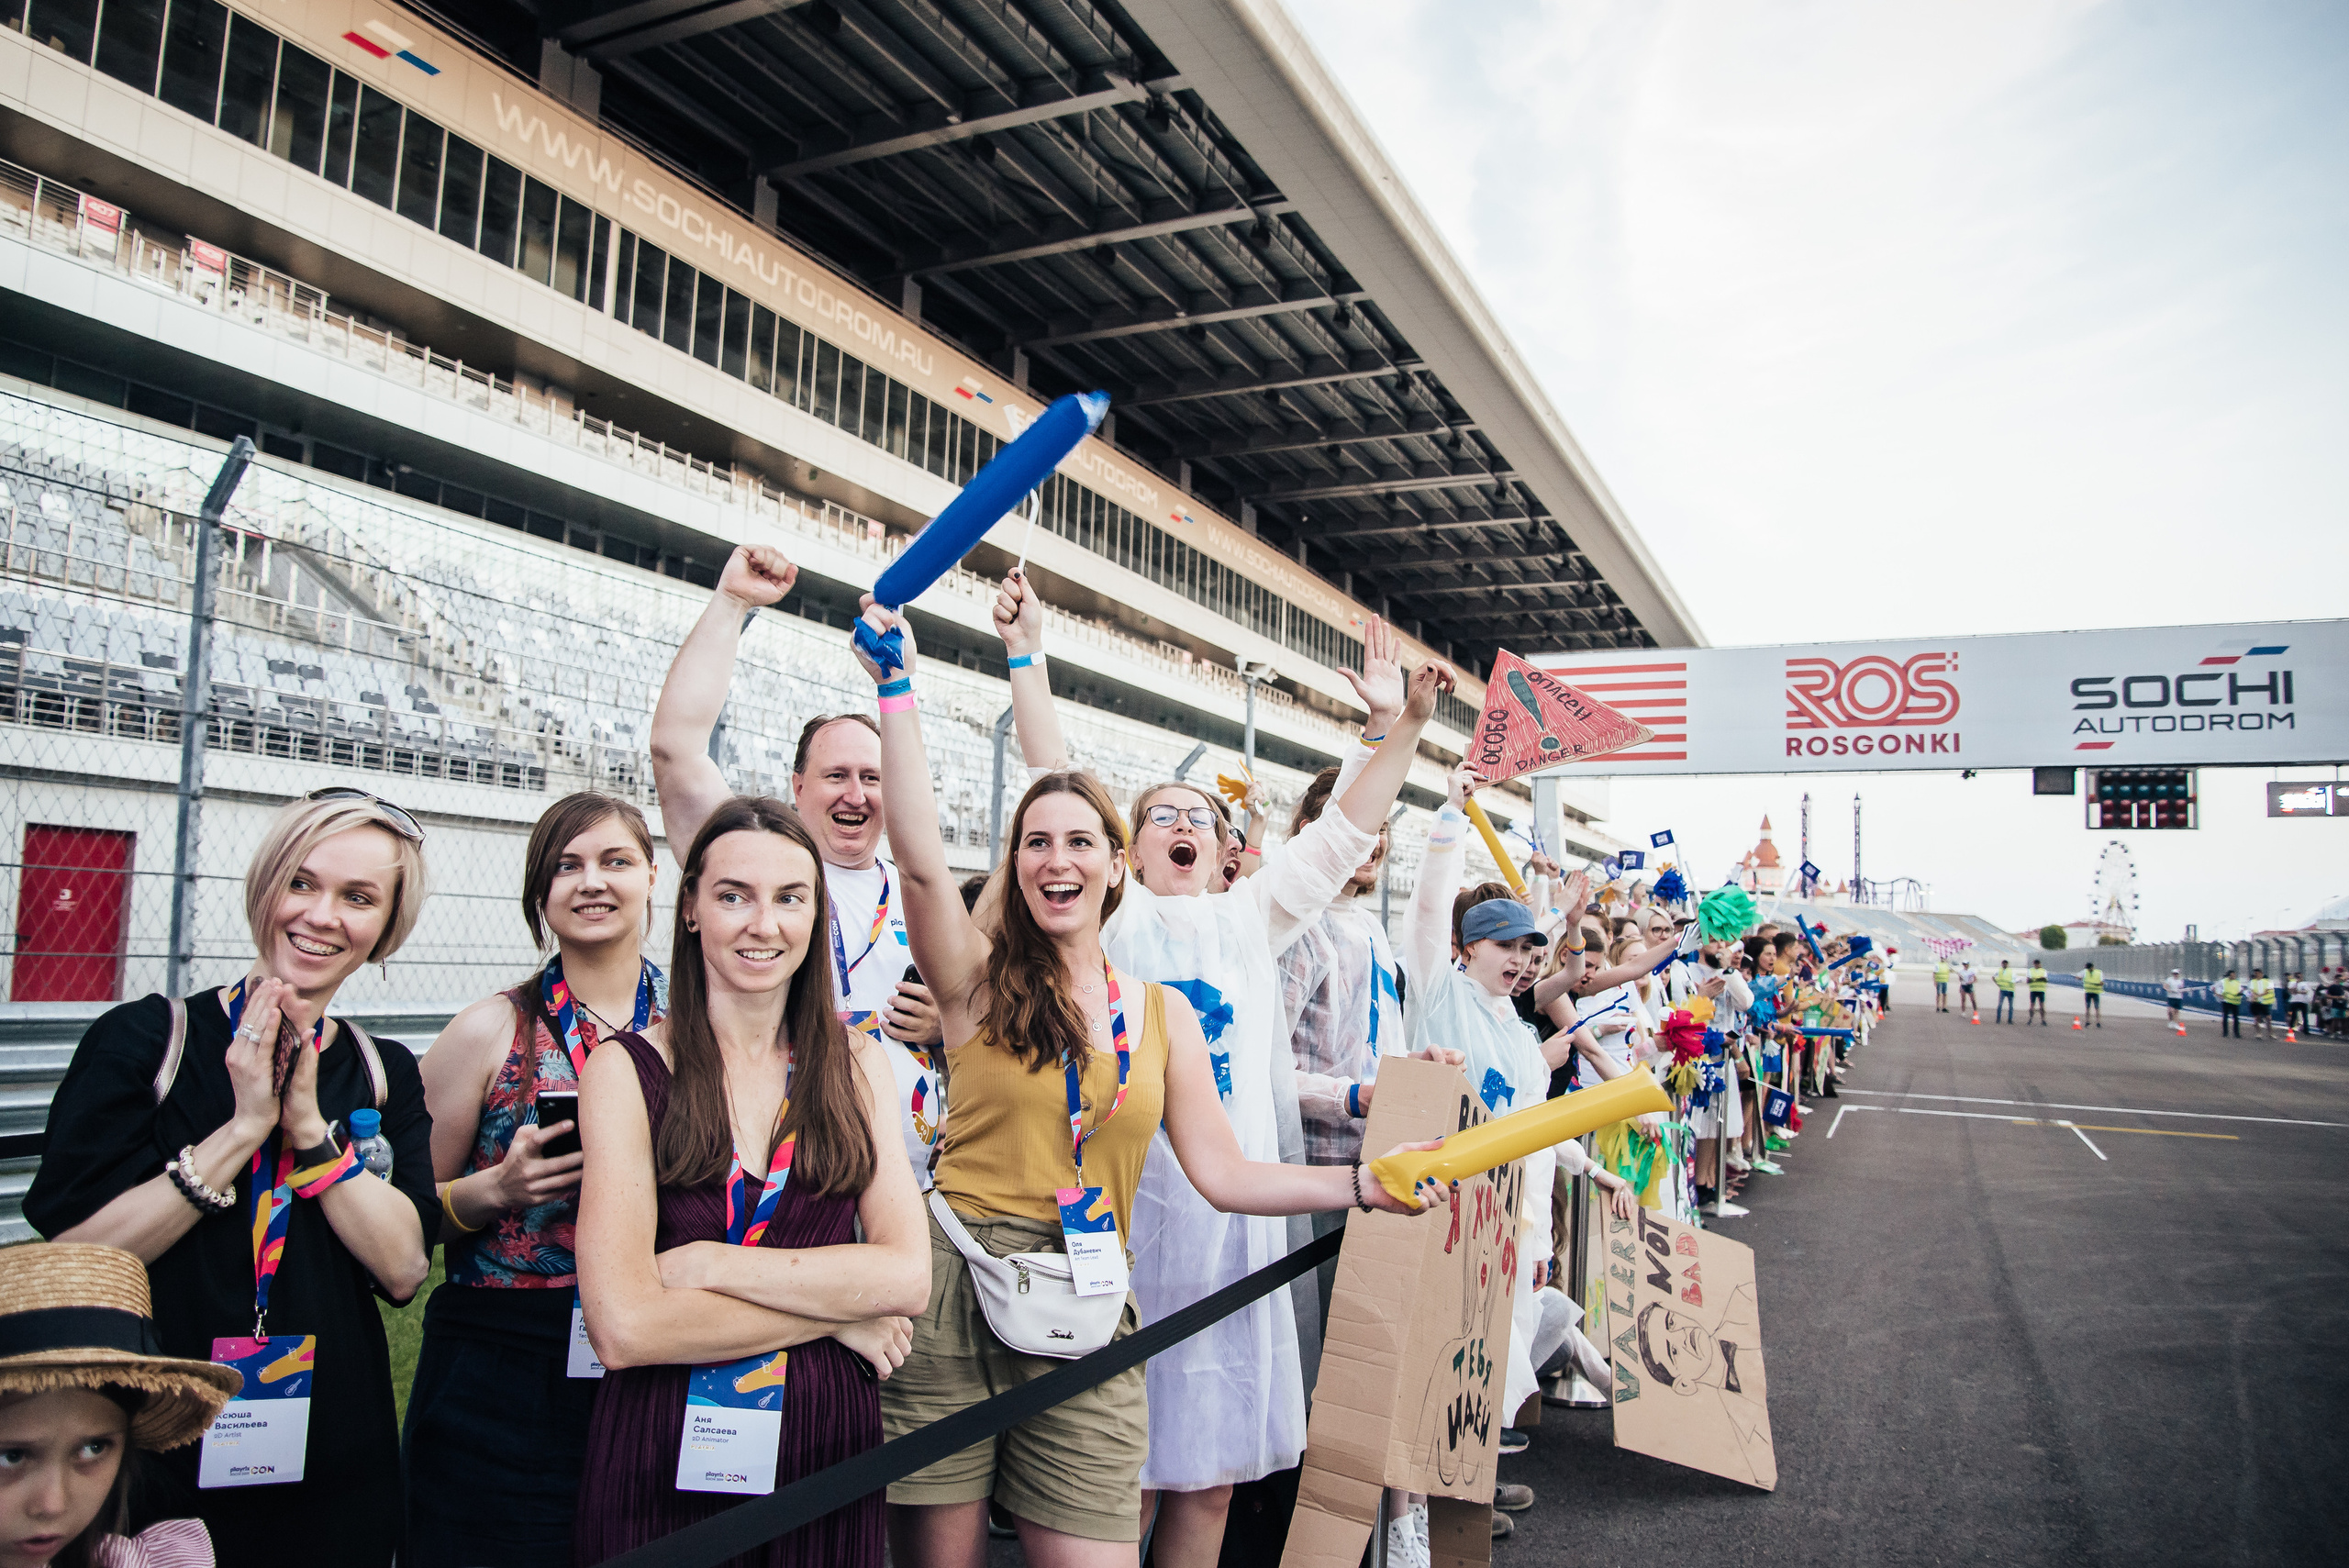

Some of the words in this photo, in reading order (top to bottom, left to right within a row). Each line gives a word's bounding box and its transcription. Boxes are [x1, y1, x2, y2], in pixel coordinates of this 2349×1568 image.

[492, 92, 934, 377] WWW.SOCHIAUTODROM.RU
[1786, 651, 1961, 729] ROS
[2070, 671, 2294, 711] SOCHI
[2072, 712, 2296, 735] AUTODROM
[1786, 732, 1961, 757] ROSGONKI
[1515, 744, 1586, 772] DANGER
[1637, 1205, 1673, 1296] NOT
[1675, 1232, 1703, 1308] BAD
[215, 1421, 268, 1430] Васильева
[693, 1425, 737, 1436] Салсаева
[695, 1415, 712, 1423] Аня
[250, 1465, 274, 1474] CON
[725, 1473, 747, 1483] CON
